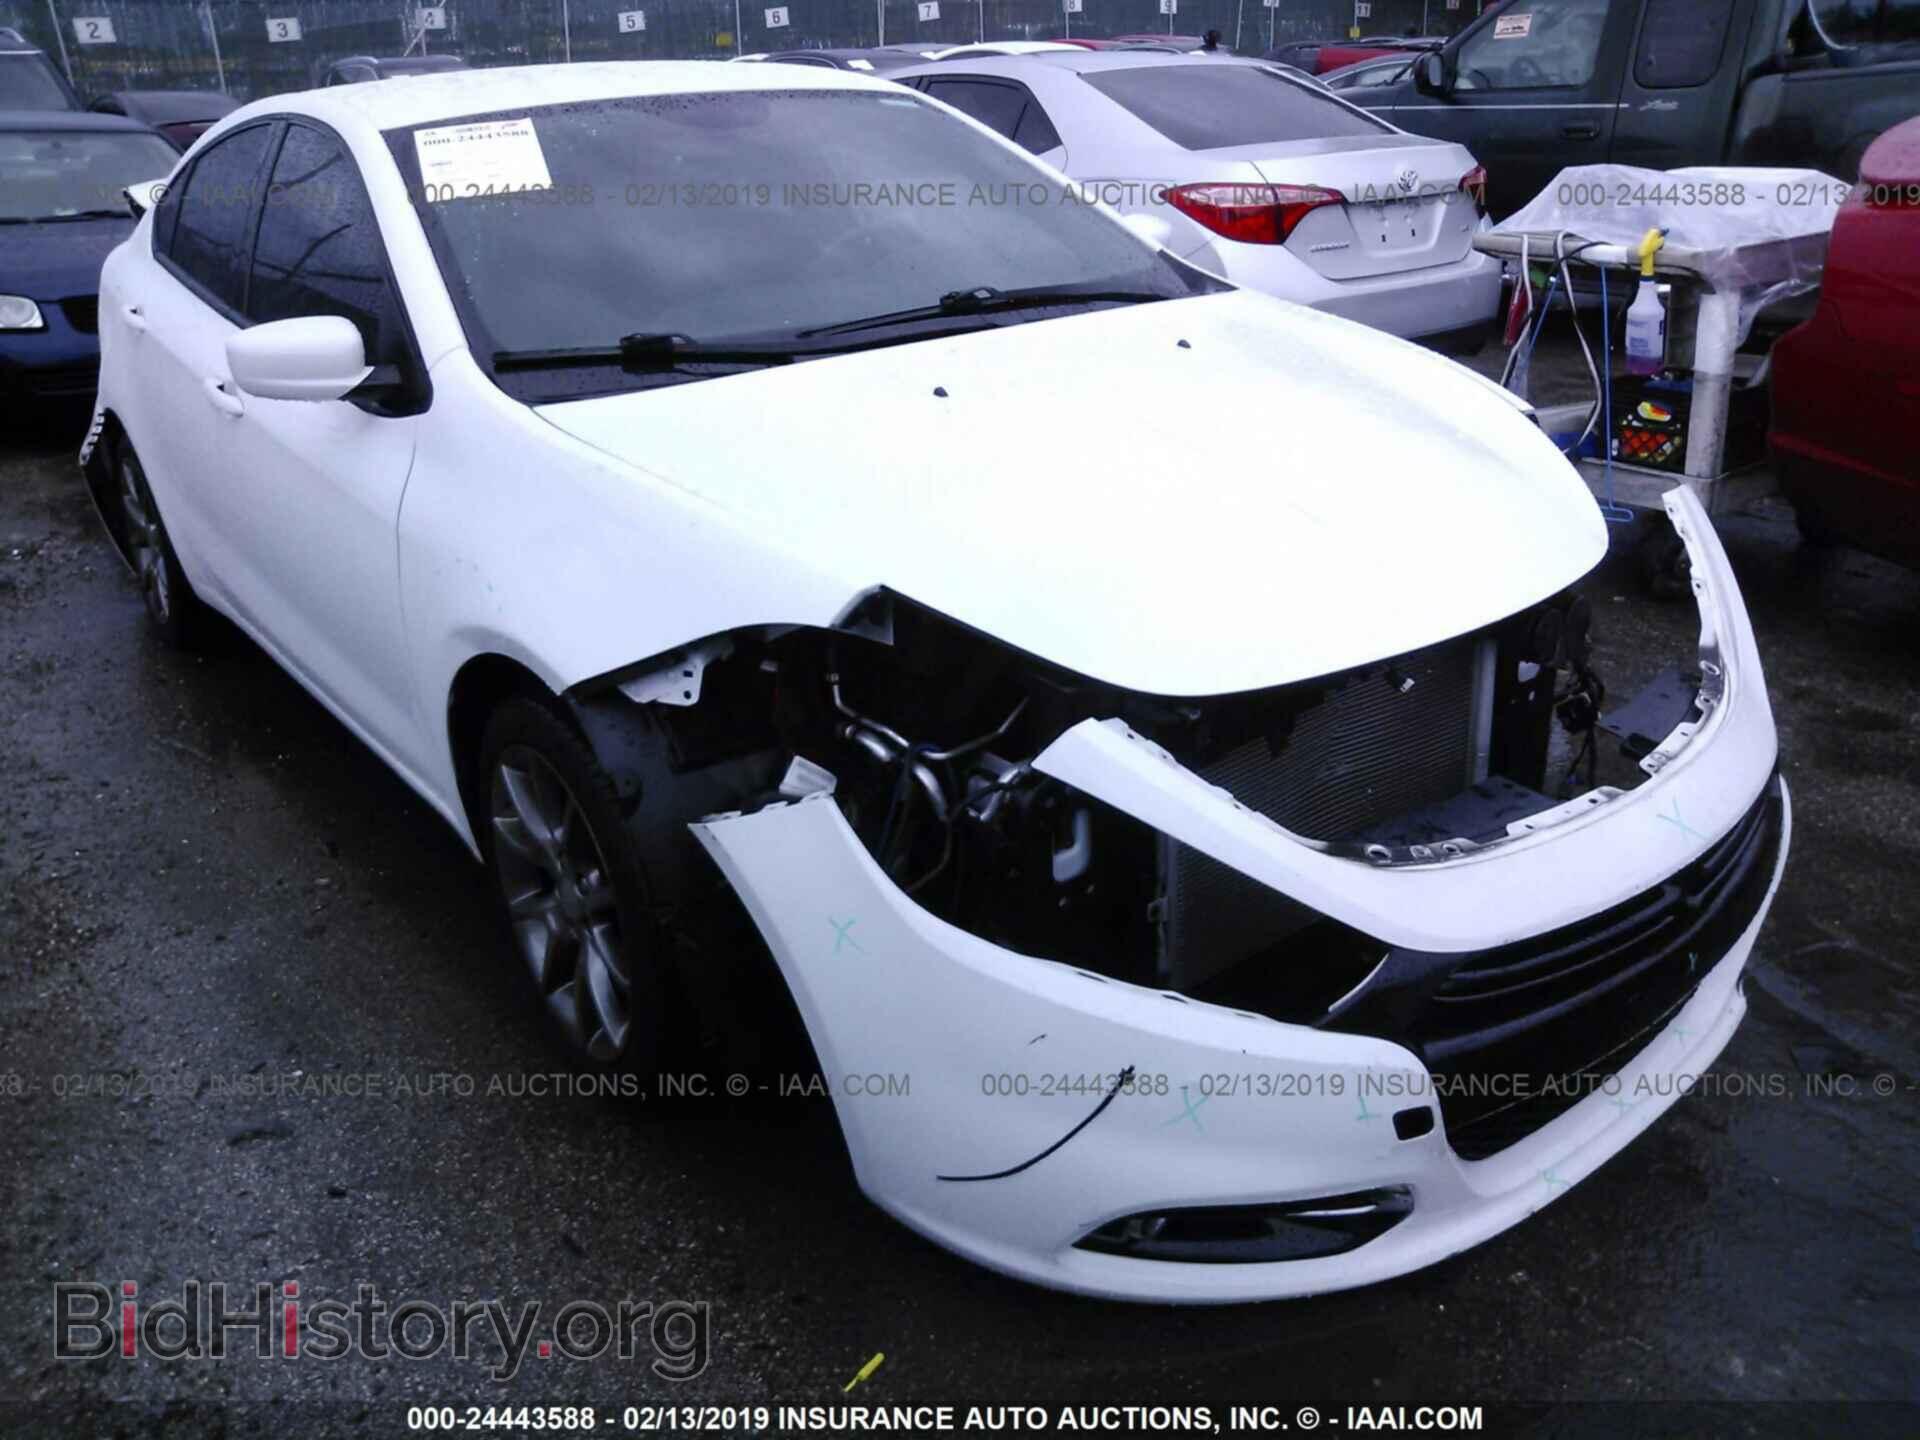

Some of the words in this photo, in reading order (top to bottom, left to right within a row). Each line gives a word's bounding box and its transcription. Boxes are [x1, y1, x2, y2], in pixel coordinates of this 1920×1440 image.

[772, 11, 781, 24] 6
[924, 5, 932, 17] 7
[626, 15, 636, 29] 5
[86, 22, 102, 39] 2
[276, 22, 288, 38] 3
